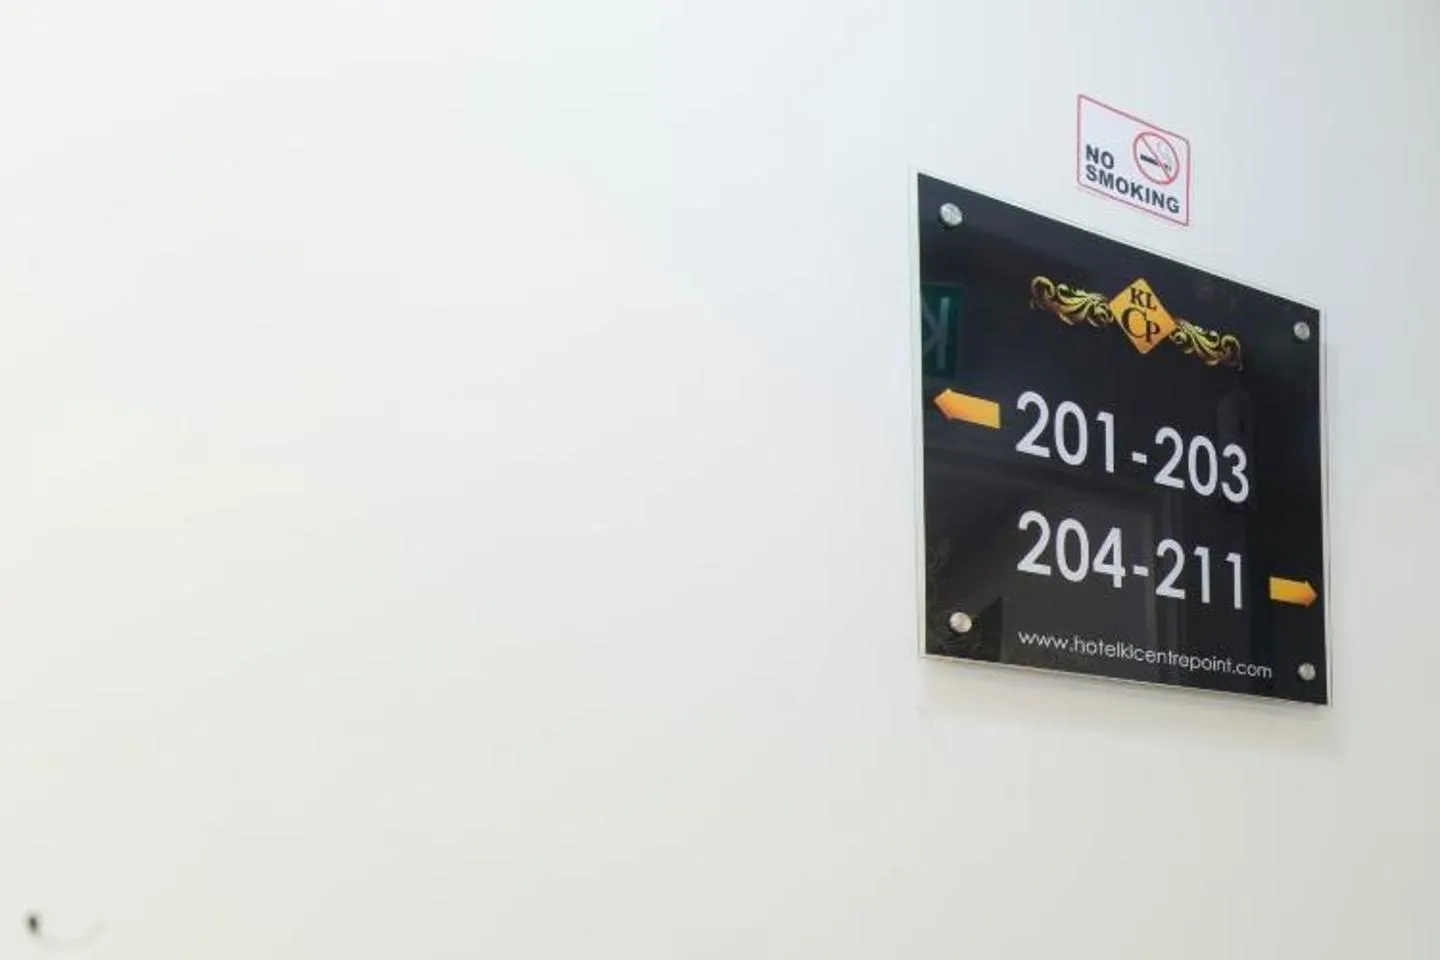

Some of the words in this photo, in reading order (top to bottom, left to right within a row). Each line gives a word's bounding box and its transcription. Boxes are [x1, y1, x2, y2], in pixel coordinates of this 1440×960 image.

[1086, 144, 1115, 170] NO
[1086, 165, 1180, 214] SMOKING
[1130, 287, 1157, 312] KL
[1122, 307, 1161, 343] CP
[1015, 391, 1250, 504] 201-203
[1017, 510, 1242, 609] 204-211
